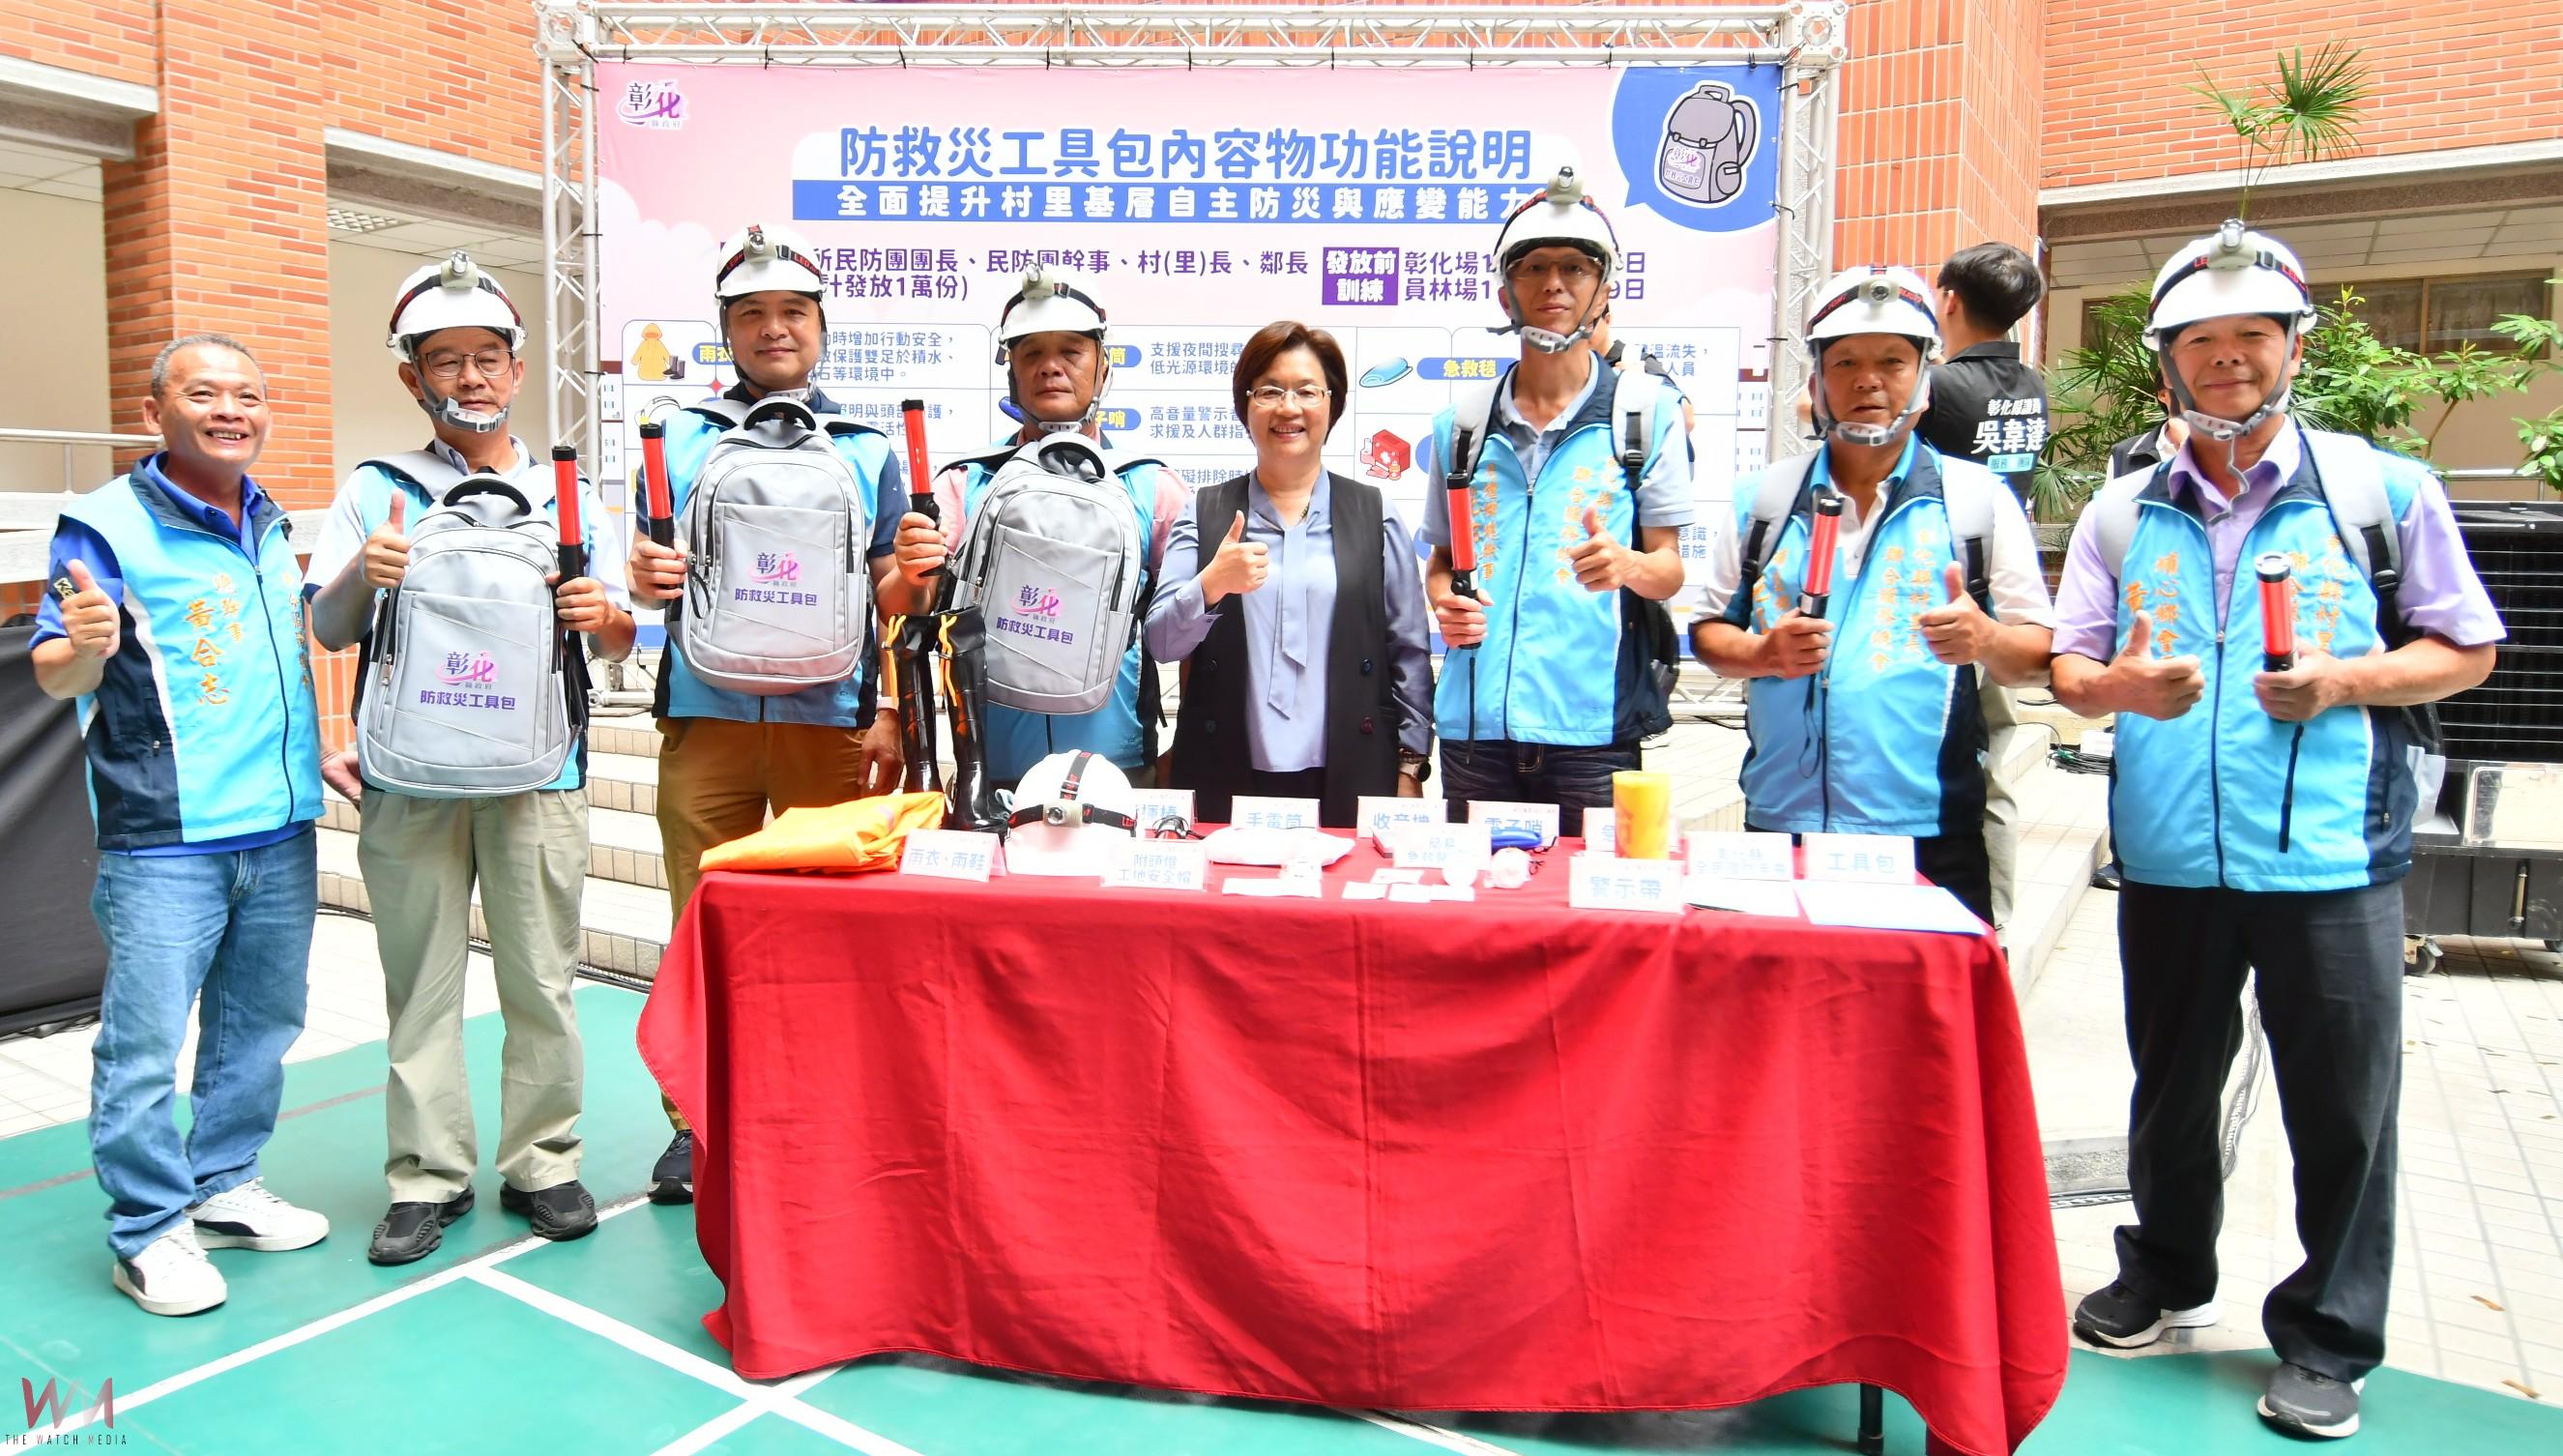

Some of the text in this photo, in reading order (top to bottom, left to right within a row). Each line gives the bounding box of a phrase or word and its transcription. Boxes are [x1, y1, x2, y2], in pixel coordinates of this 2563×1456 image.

[839, 126, 1531, 180] 防救災工具包內容物功能說明
[836, 185, 1547, 219] 全面提升村里基層自主防災與應變能力
[1325, 248, 1396, 276] 發放前
[1336, 277, 1384, 303] 訓練
[1642, 343, 1708, 360] 溫流失，
[1442, 360, 1498, 378] 急救毯
[734, 587, 819, 607] 防救災工具包
[995, 616, 1075, 645] 防救災工具包
[185, 597, 231, 706] 黃合志
[446, 651, 495, 683] 彰化
[420, 689, 516, 711] 防救災工具包
[1827, 853, 1896, 874] 工具包
[1589, 875, 1662, 901] 警示帶
